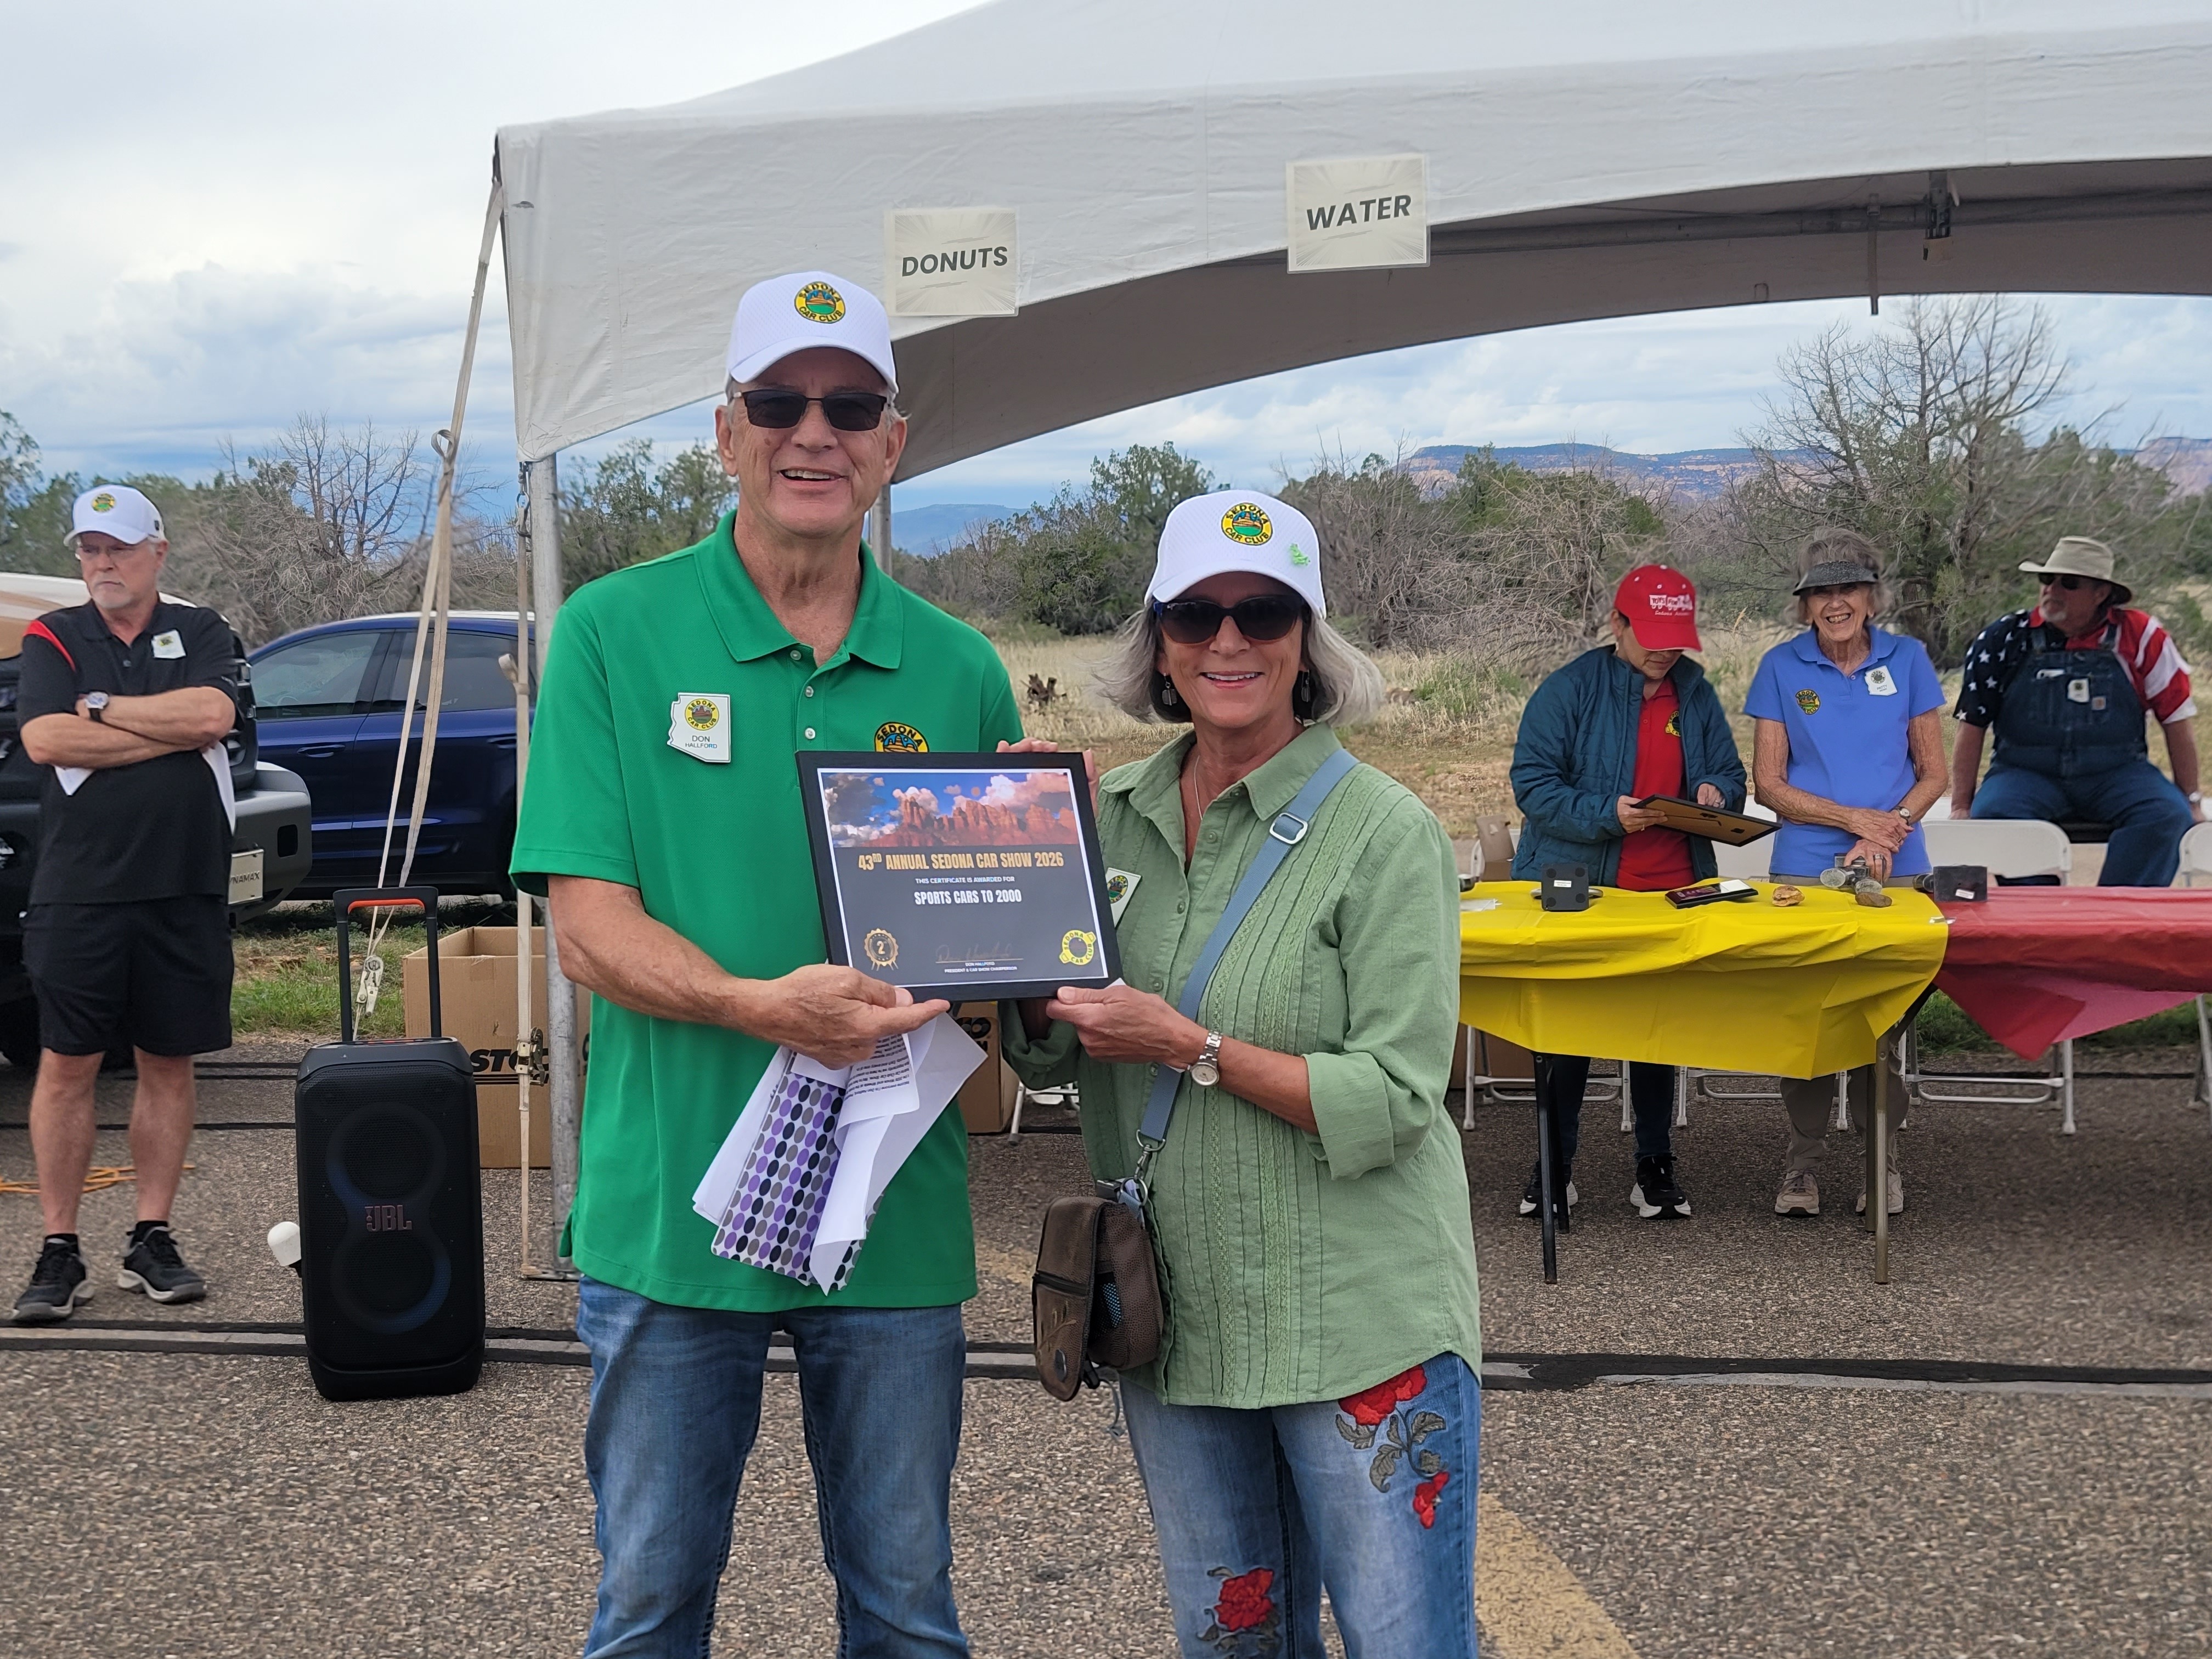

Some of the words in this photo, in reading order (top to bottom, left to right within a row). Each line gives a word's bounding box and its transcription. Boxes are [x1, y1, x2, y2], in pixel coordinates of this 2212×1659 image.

[1306, 194, 1412, 231] WATER
[902, 246, 1008, 277] DONUTS
[799, 306, 817, 319] CAR
[819, 309, 843, 322] CLUB
[1226, 505, 1269, 524] SEDONA
[1225, 527, 1243, 541] CAR
[1244, 532, 1269, 544] CLUB
[688, 700, 716, 712] SEDONA
[687, 716, 699, 728] CAR
[701, 718, 716, 729] CLUB
[877, 725, 923, 747] SEDONA
[885, 854, 930, 870] ANNUAL
[930, 853, 975, 869] SEDONA
[976, 853, 999, 868] CAR
[1000, 852, 1032, 868] SHOW
[1034, 851, 1064, 867] 2026
[914, 890, 952, 905] SPORTS
[953, 890, 979, 904] CARS
[980, 889, 994, 903] TO
[995, 889, 1022, 903] 2000
[365, 1205, 413, 1232] JBL
